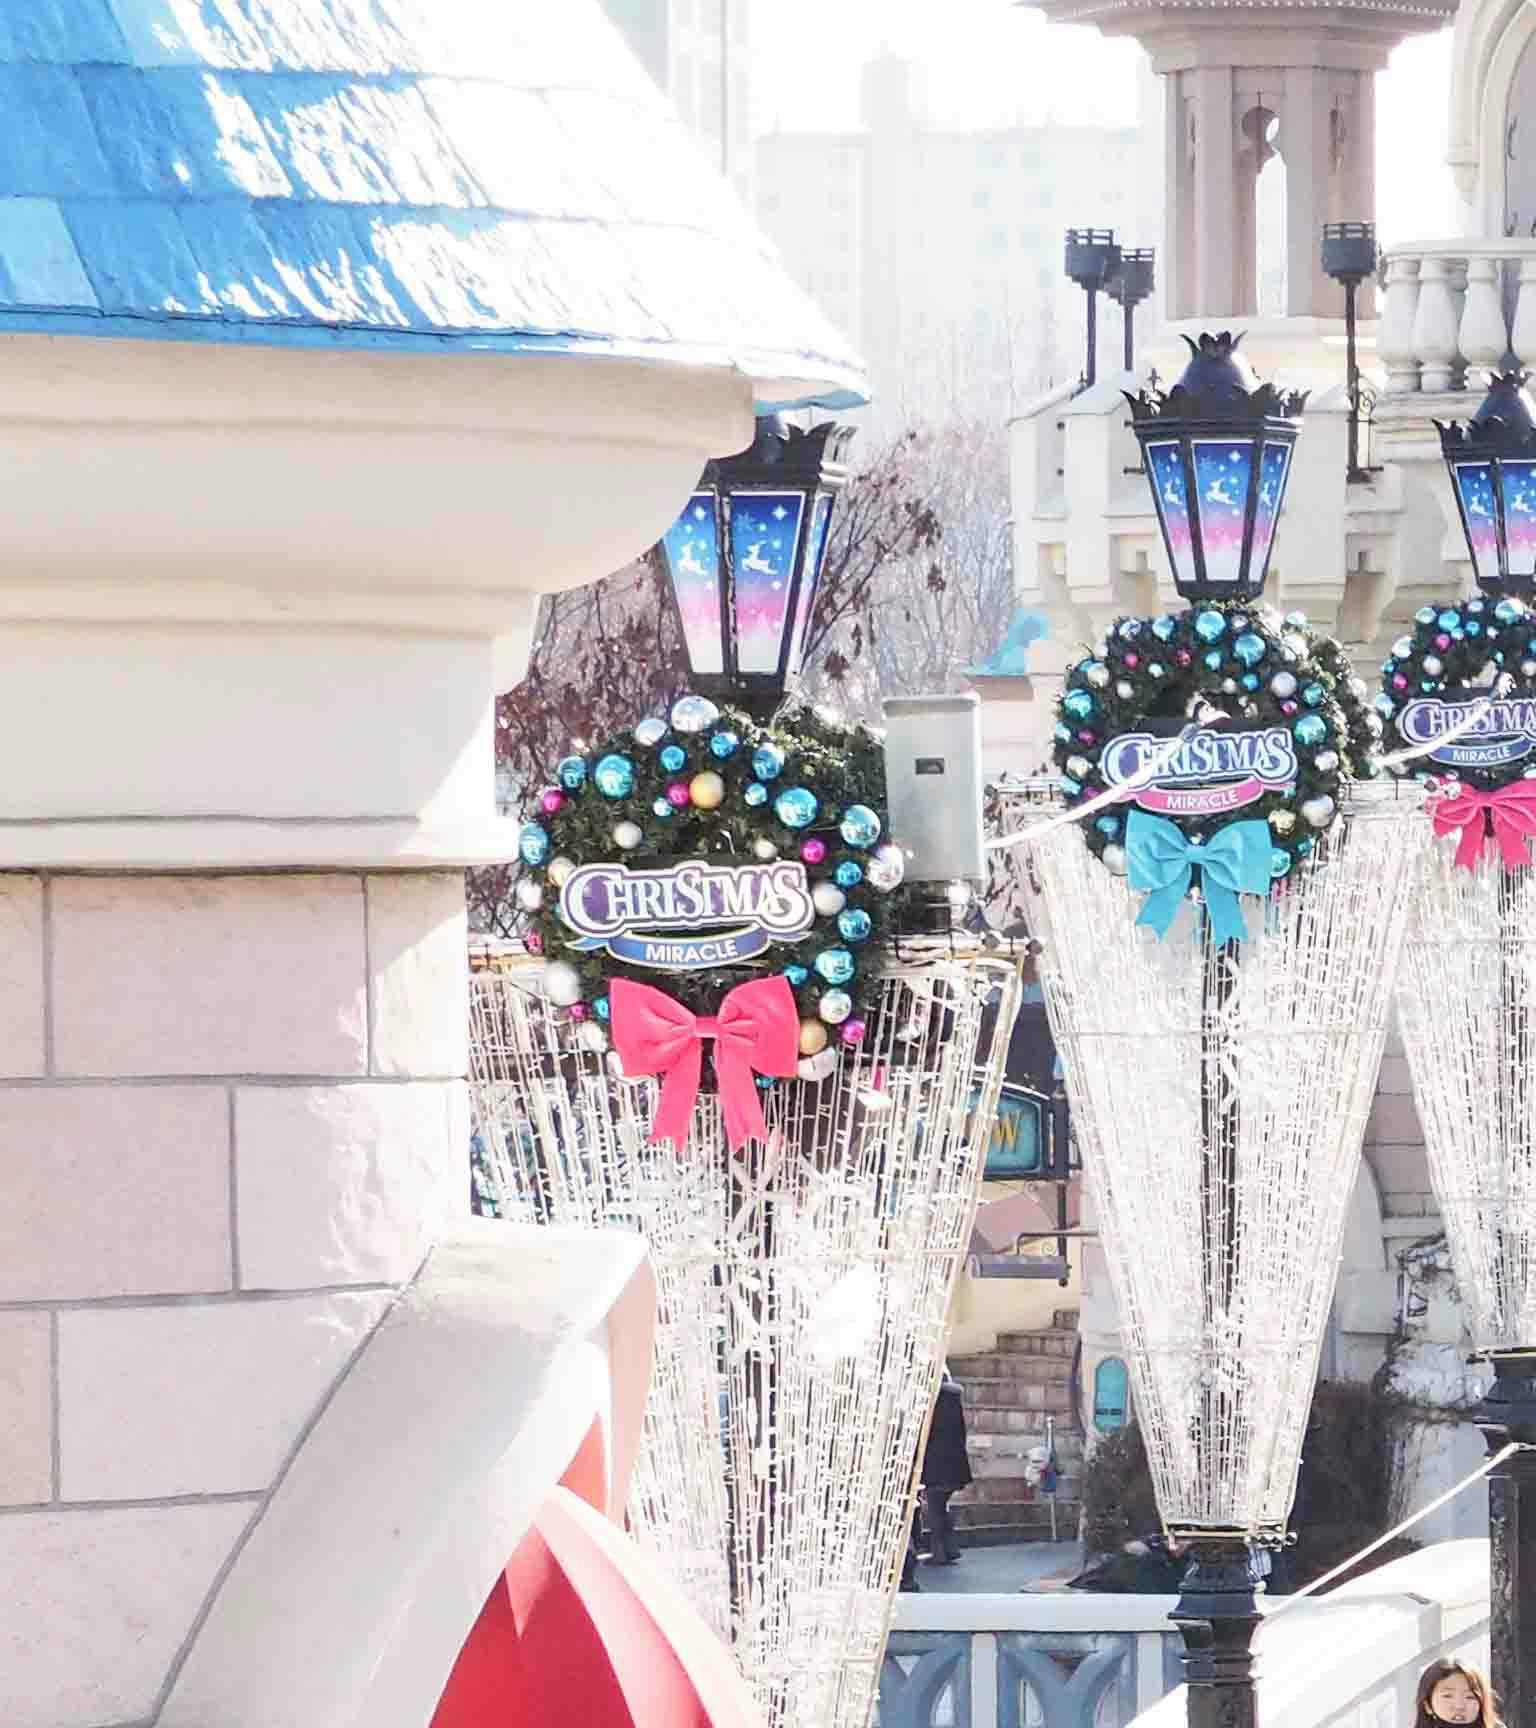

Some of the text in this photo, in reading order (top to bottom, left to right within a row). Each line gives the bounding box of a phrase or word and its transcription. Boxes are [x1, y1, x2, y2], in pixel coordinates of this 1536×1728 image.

[1106, 732, 1292, 784] CHRISTMAS
[1452, 745, 1511, 762] MIRACLE
[1167, 790, 1240, 809] MIRACLE
[567, 867, 813, 932] CHRISTMAS
[645, 940, 739, 963] MIRACLE
